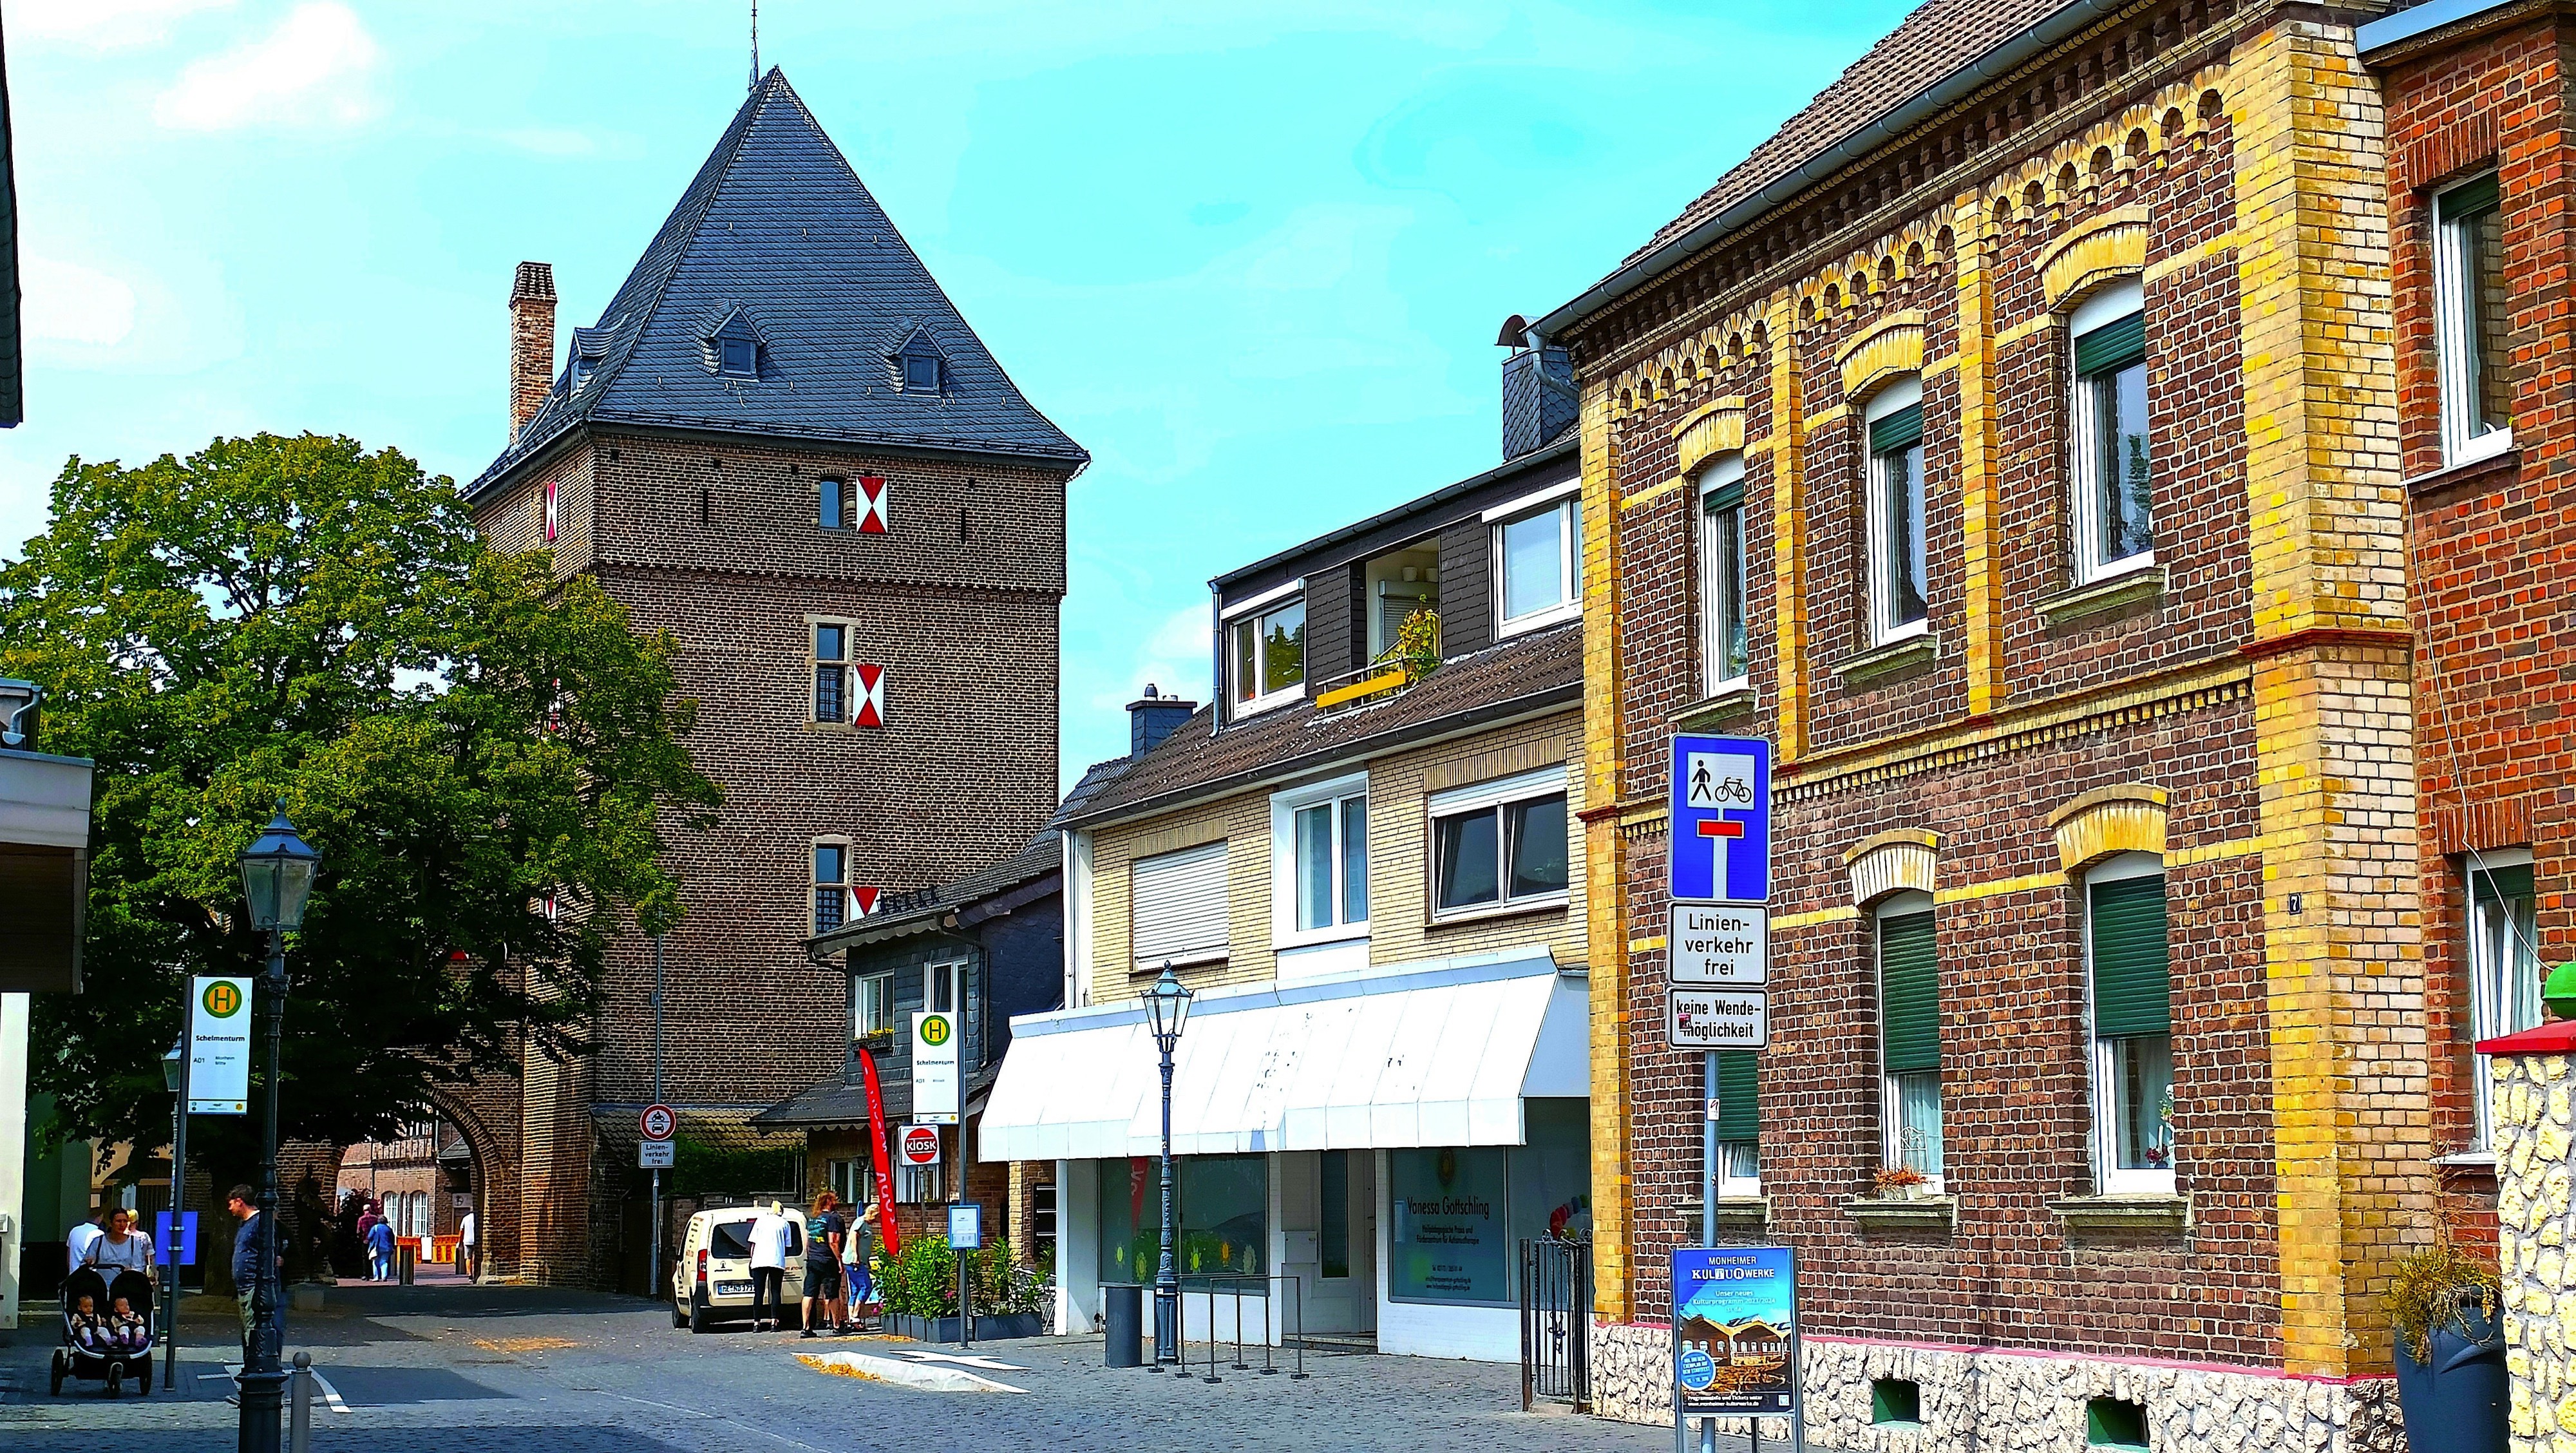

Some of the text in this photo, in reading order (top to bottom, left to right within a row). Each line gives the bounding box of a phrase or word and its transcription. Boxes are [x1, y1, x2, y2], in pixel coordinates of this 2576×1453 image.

[2291, 896, 2298, 911] 7
[1689, 913, 1750, 931] Linien-
[1685, 936, 1754, 954] verkehr
[1704, 958, 1734, 976] frei
[214, 989, 231, 1010] H
[1676, 999, 1761, 1016] keine Wende-
[929, 1021, 942, 1039] H
[906, 1138, 936, 1152] KIOSK
[1406, 1195, 1489, 1220] Vanessa Gottschling
[1709, 1256, 1757, 1266] MONHEIMER
[1691, 1268, 1775, 1280] KULTURWERKE
